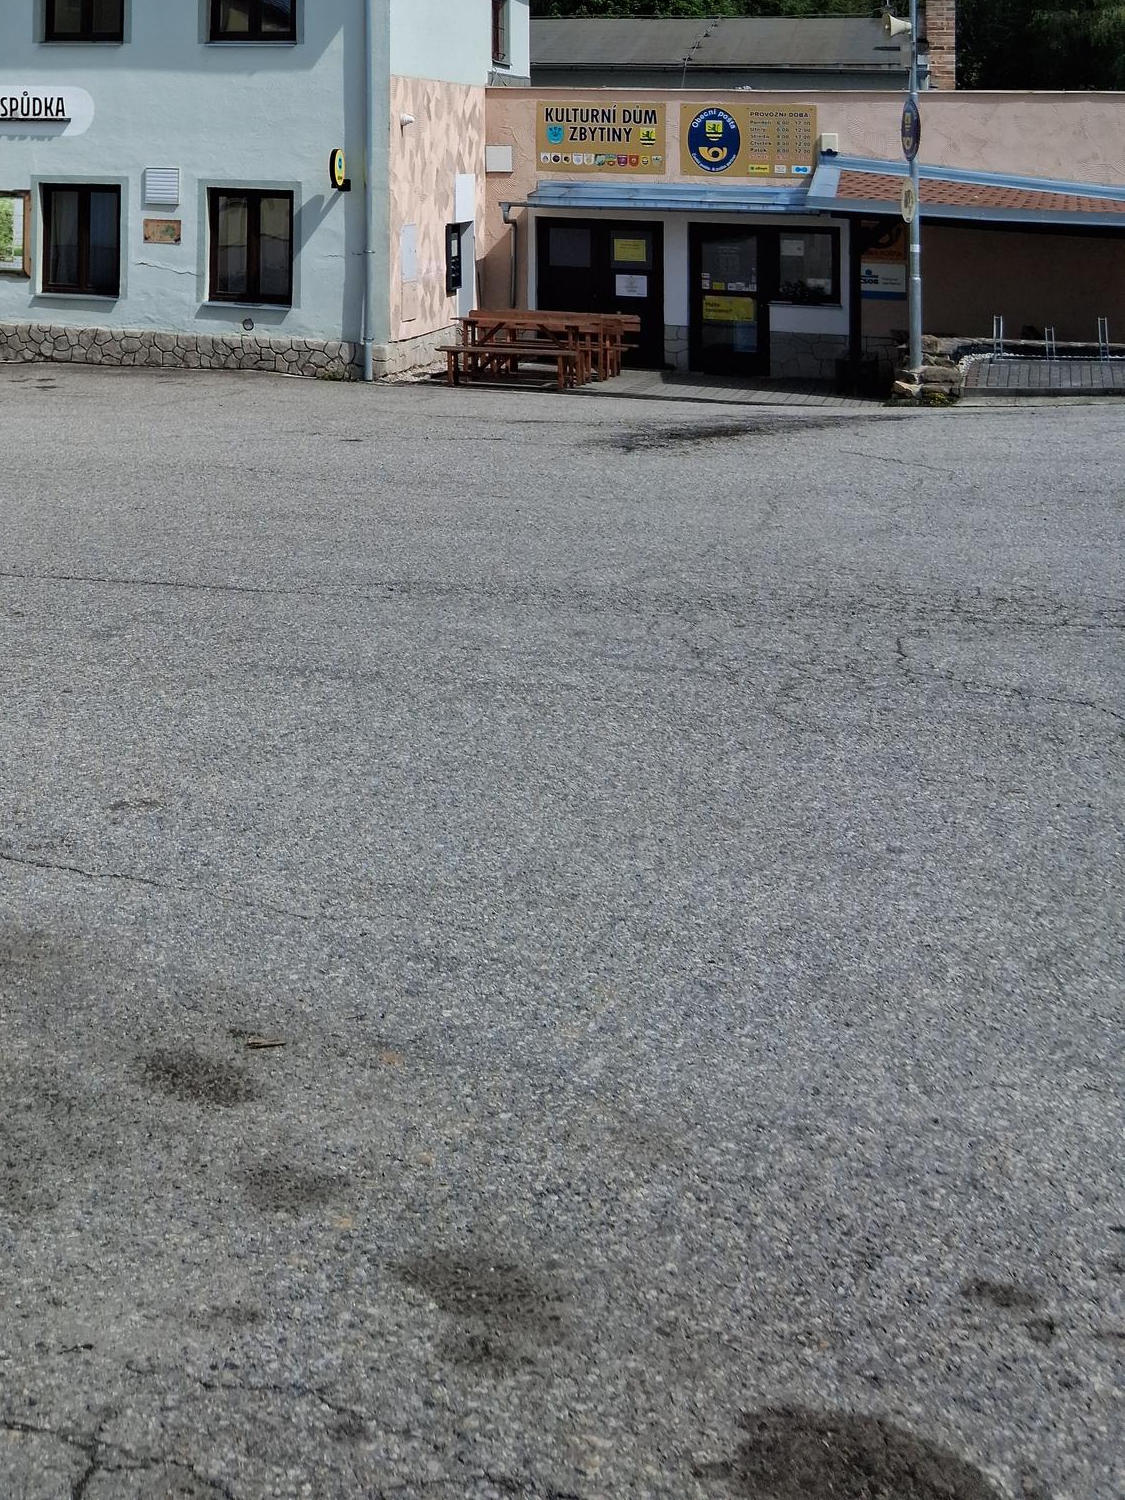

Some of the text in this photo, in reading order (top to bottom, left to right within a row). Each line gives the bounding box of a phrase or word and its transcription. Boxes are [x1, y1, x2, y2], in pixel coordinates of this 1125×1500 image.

[544, 104, 658, 125] KULTURNÍ DŮM
[691, 109, 717, 129] Obecní
[569, 126, 633, 142] ZBYTINY
